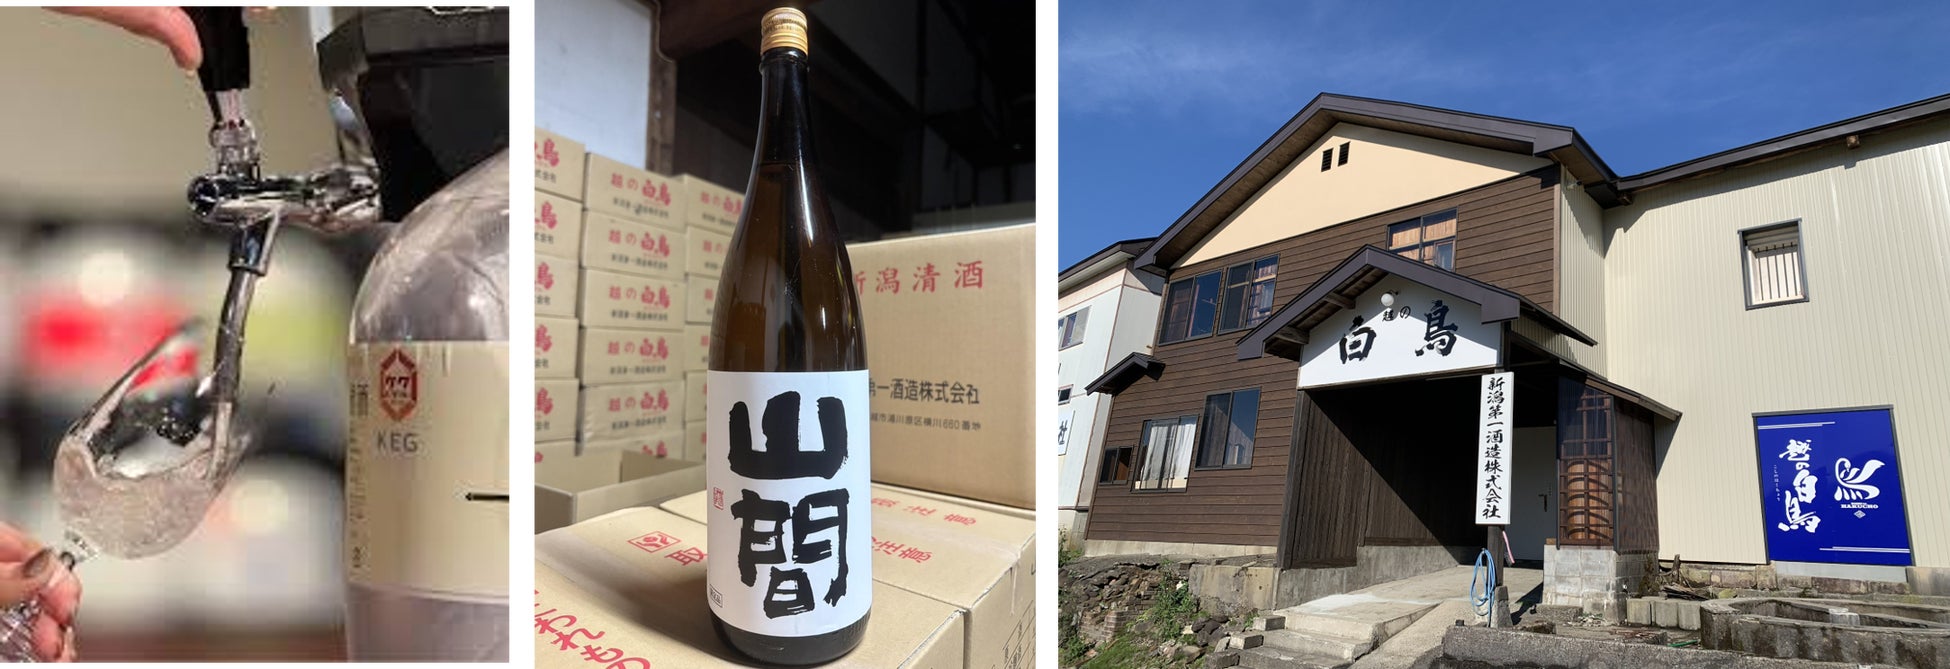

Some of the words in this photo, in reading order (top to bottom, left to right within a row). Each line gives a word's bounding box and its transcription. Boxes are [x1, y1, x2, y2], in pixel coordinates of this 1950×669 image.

[377, 431, 418, 453] KEG
[1483, 377, 1505, 519] 新潟第一酒造株式会社
